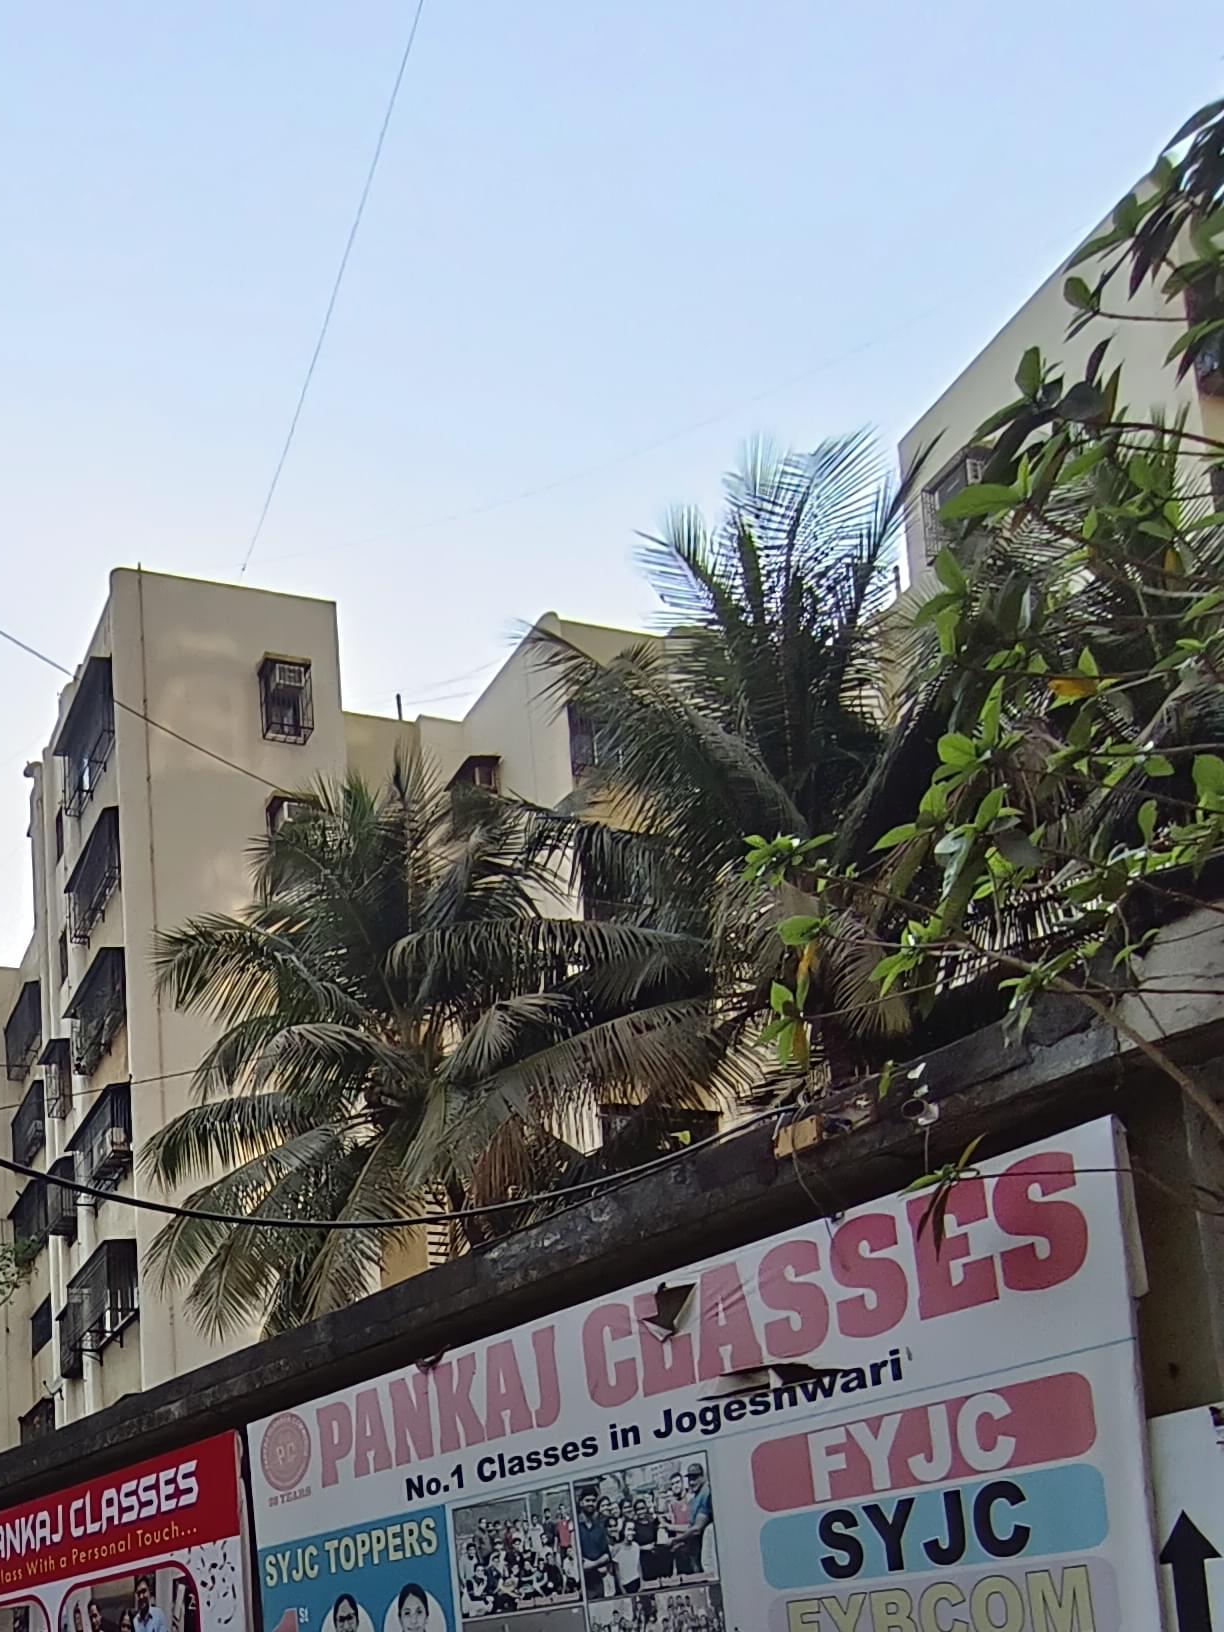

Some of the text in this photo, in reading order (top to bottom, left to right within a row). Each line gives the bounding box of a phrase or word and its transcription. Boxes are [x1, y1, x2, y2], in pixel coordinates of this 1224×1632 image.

[316, 1152, 1088, 1488] PANKAJ CLASSES
[405, 1347, 904, 1501] No.1 Classes in Jogeshwari
[806, 1393, 1017, 1502] FYJC
[26, 1559, 56, 1575] With
[59, 1557, 67, 1567] a
[72, 1538, 132, 1565] Personal
[137, 1522, 197, 1546] Touch...
[69, 1459, 198, 1539] CLASSES
[819, 1480, 1031, 1580] SYJC
[265, 1517, 438, 1588] SYJC TOPPERS
